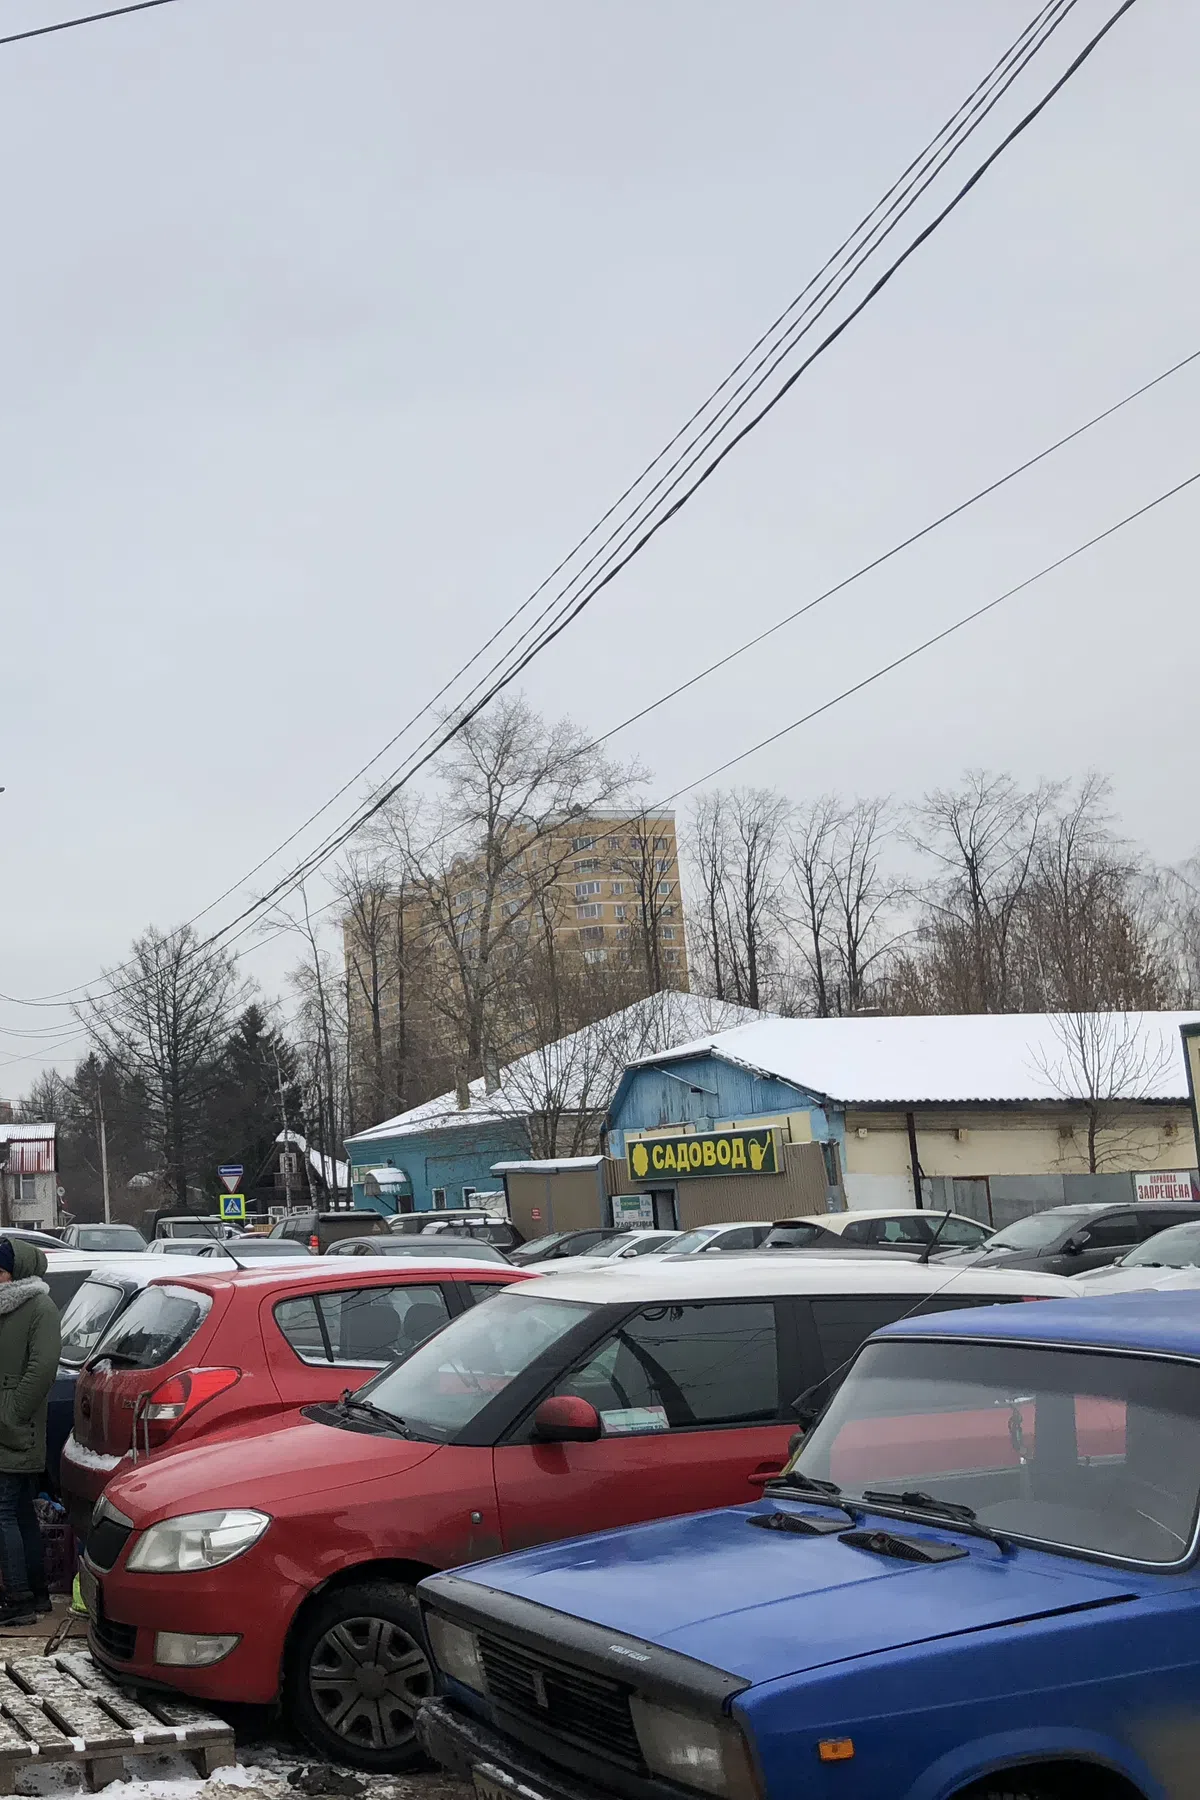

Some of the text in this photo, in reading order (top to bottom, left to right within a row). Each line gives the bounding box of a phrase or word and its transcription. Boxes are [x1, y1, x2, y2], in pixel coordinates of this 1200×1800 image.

[652, 1138, 747, 1172] САДОВОД
[1150, 1175, 1176, 1183] ПАРКОВКА
[1138, 1184, 1190, 1201] ЗАПРЕЩЕНА
